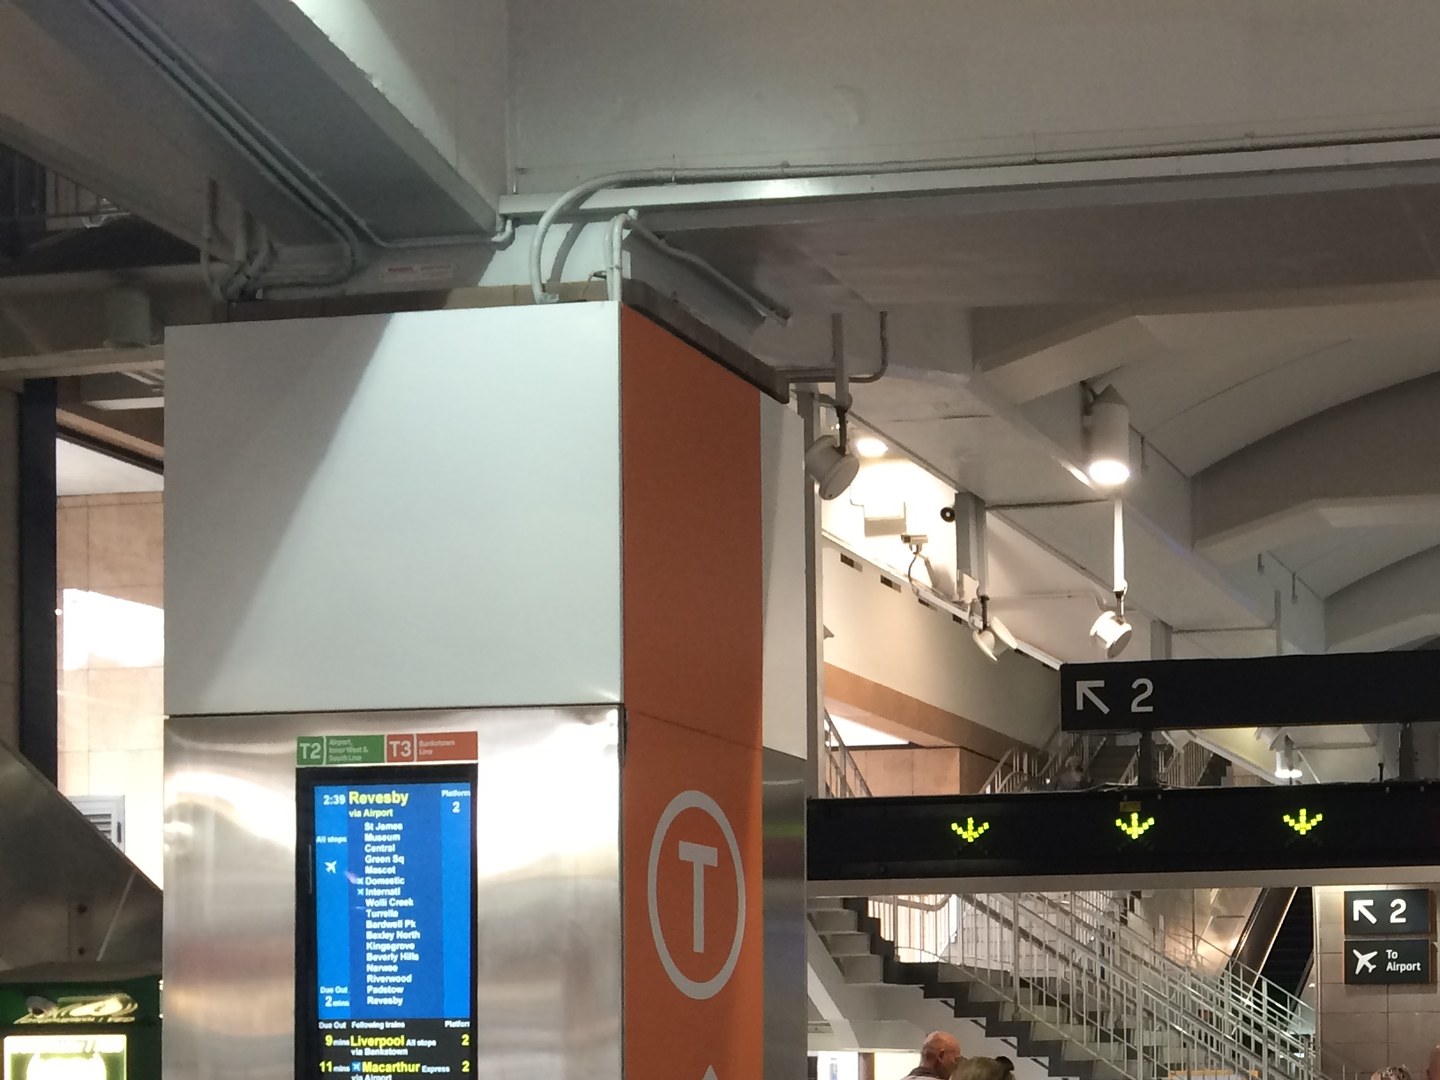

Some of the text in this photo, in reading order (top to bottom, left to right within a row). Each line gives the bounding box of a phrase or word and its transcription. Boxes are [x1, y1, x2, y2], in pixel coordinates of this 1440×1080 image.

[1131, 680, 1154, 714] 2
[300, 743, 321, 759] T2
[389, 741, 411, 757] T3
[323, 791, 408, 806] 2:39 Revesby
[452, 802, 460, 813] 2
[349, 809, 393, 818] via Airport
[364, 822, 403, 831] St James
[364, 833, 400, 841] Museum
[365, 844, 395, 852] Central
[365, 855, 404, 864] Green Sq
[365, 866, 396, 874] Mascot
[365, 877, 405, 885] Domestic
[679, 840, 718, 953] T
[389, 898, 414, 906] Creek
[366, 910, 398, 918] Turrella
[1390, 899, 1406, 923] 2
[405, 920, 416, 928] Pk
[366, 931, 420, 941] Bexley North
[366, 942, 415, 952] Kingsgrove
[367, 953, 398, 963] Beverly
[1386, 950, 1398, 959] To
[367, 964, 398, 972] Narwee
[1386, 962, 1421, 973] Airport
[367, 974, 412, 983] Riverwood
[367, 985, 404, 994] Padstow
[325, 996, 332, 1007] 2
[367, 996, 403, 1006] Revesby
[325, 1035, 405, 1048] 9 Liverpool
[462, 1034, 469, 1046] 2
[319, 1062, 332, 1072] 11
[362, 1061, 420, 1072] Macarthur
[462, 1061, 469, 1072] 2
